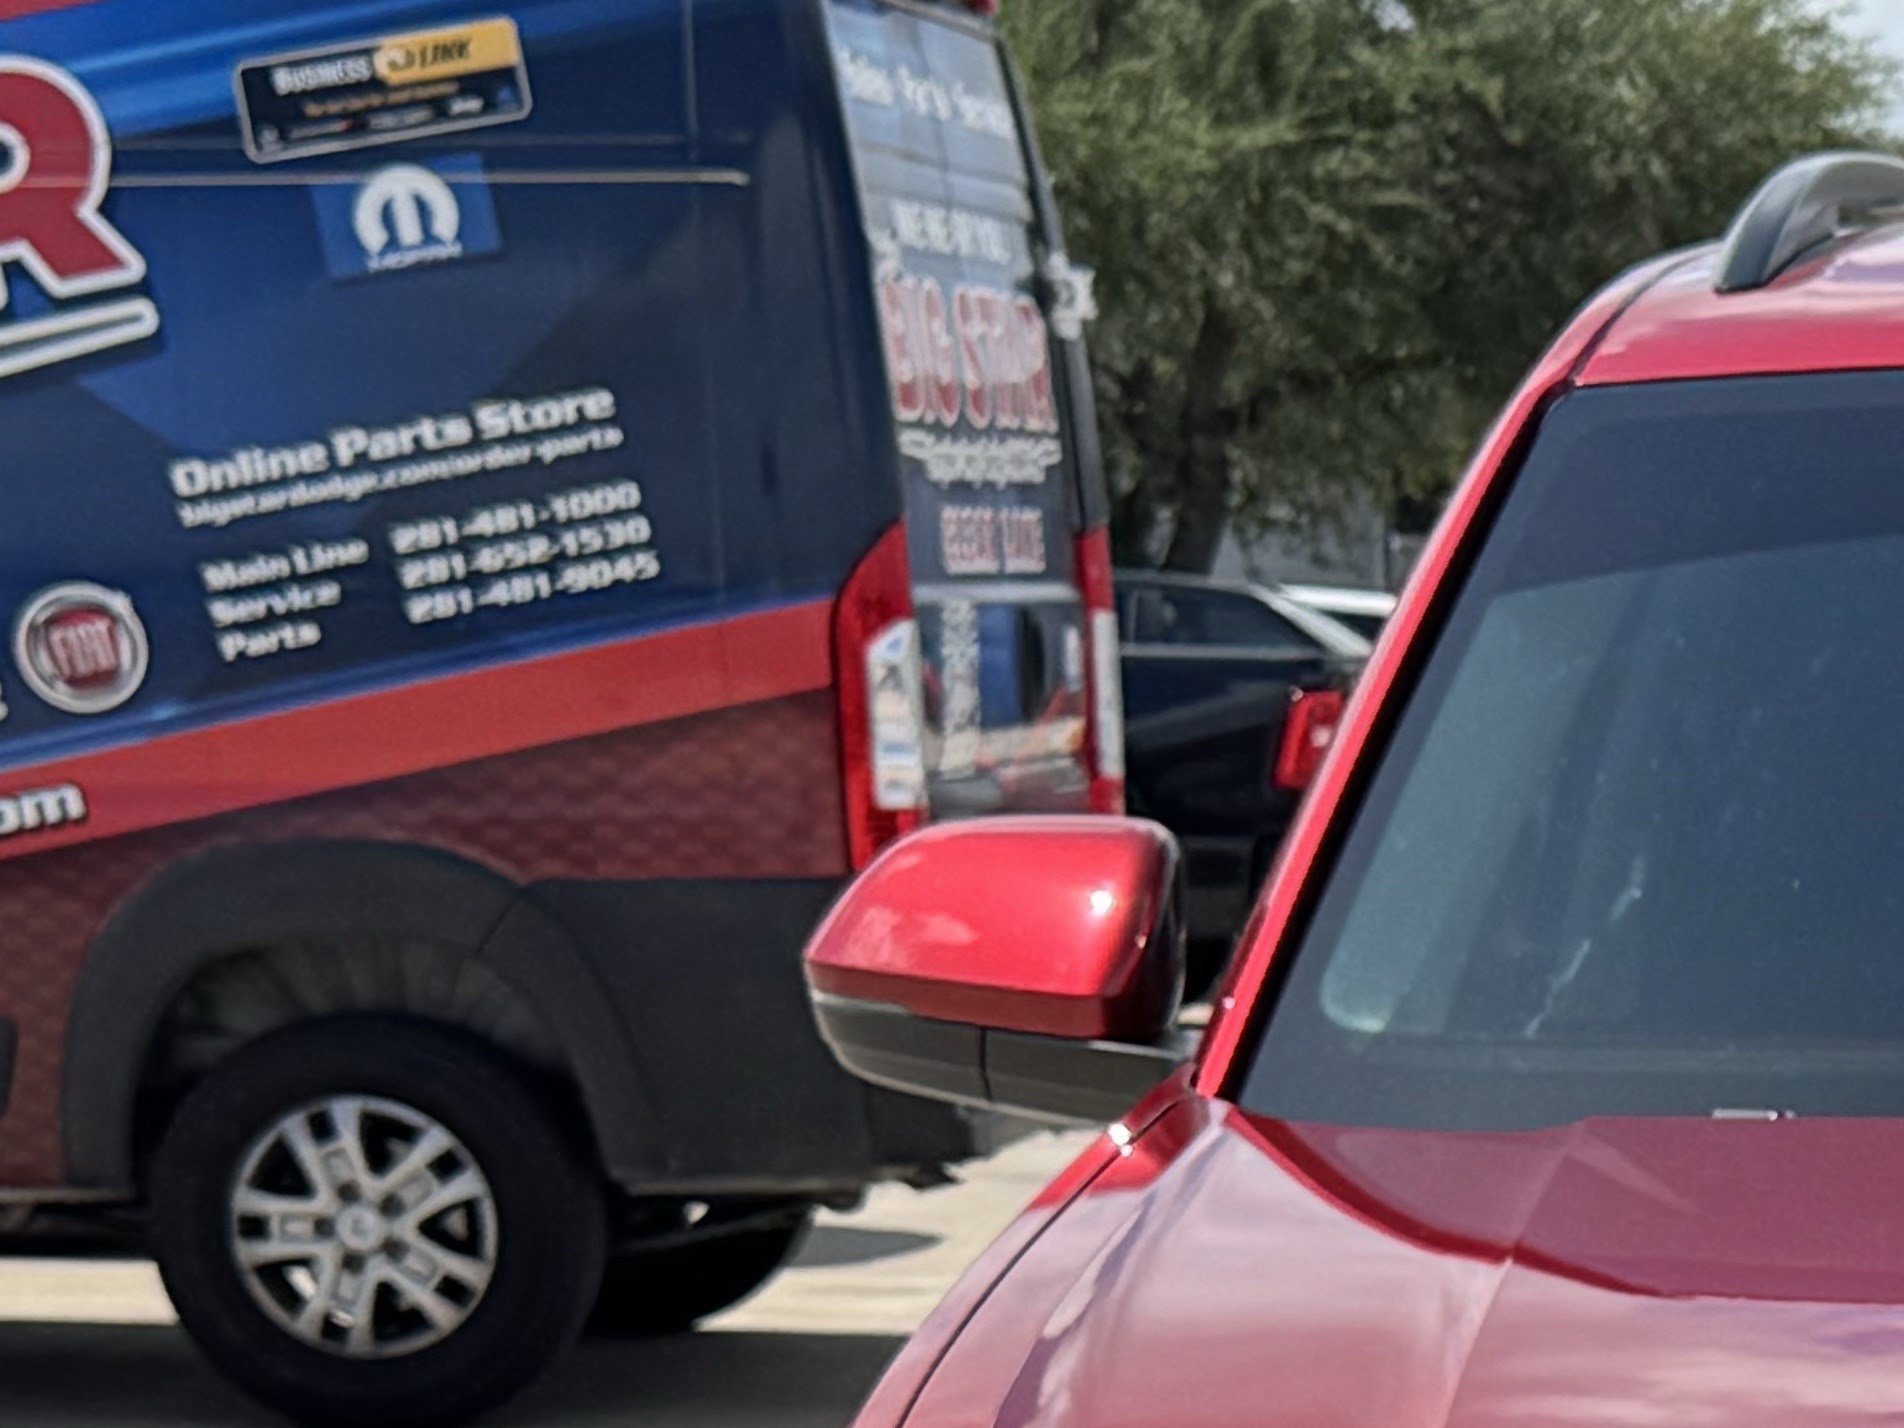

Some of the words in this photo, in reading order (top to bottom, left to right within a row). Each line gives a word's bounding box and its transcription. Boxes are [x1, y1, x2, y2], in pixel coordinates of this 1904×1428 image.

[171, 442, 330, 497] Online
[331, 416, 473, 467] Parts
[474, 387, 617, 441] Store
[203, 554, 291, 593] Main
[291, 537, 370, 576] Line
[208, 579, 342, 629] Service
[218, 621, 322, 663] Parts
